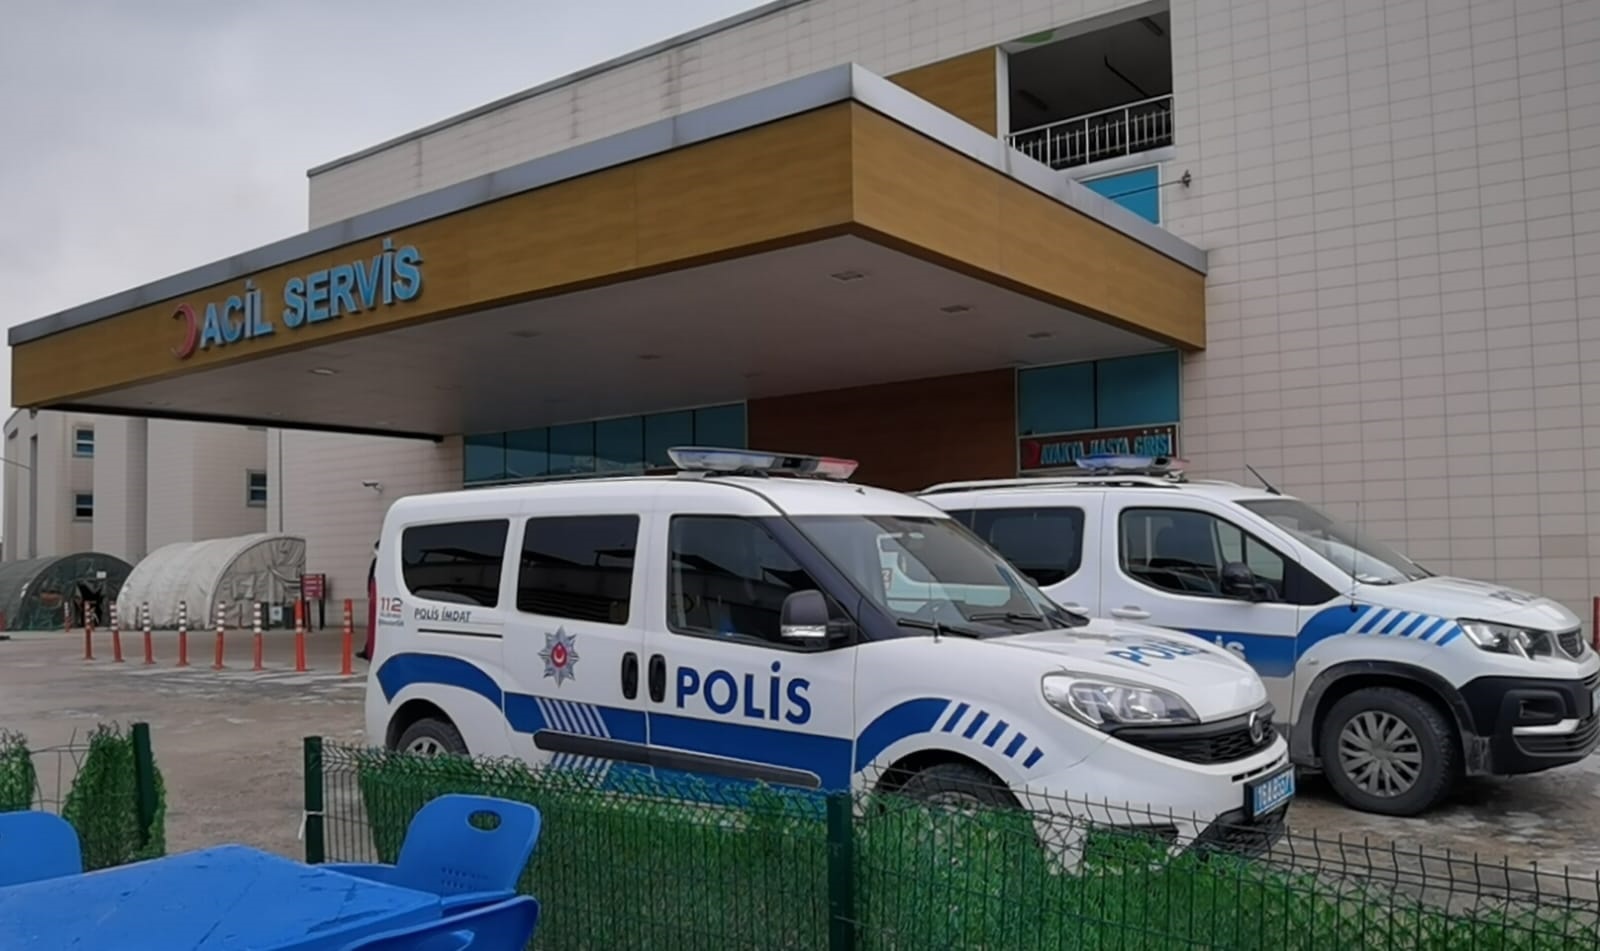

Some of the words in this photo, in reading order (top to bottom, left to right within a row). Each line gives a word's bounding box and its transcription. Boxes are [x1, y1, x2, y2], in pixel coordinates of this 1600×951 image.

[200, 279, 274, 350] ACİL
[282, 237, 423, 329] SERVİS
[381, 596, 404, 612] 112
[676, 660, 812, 725] POLİS
